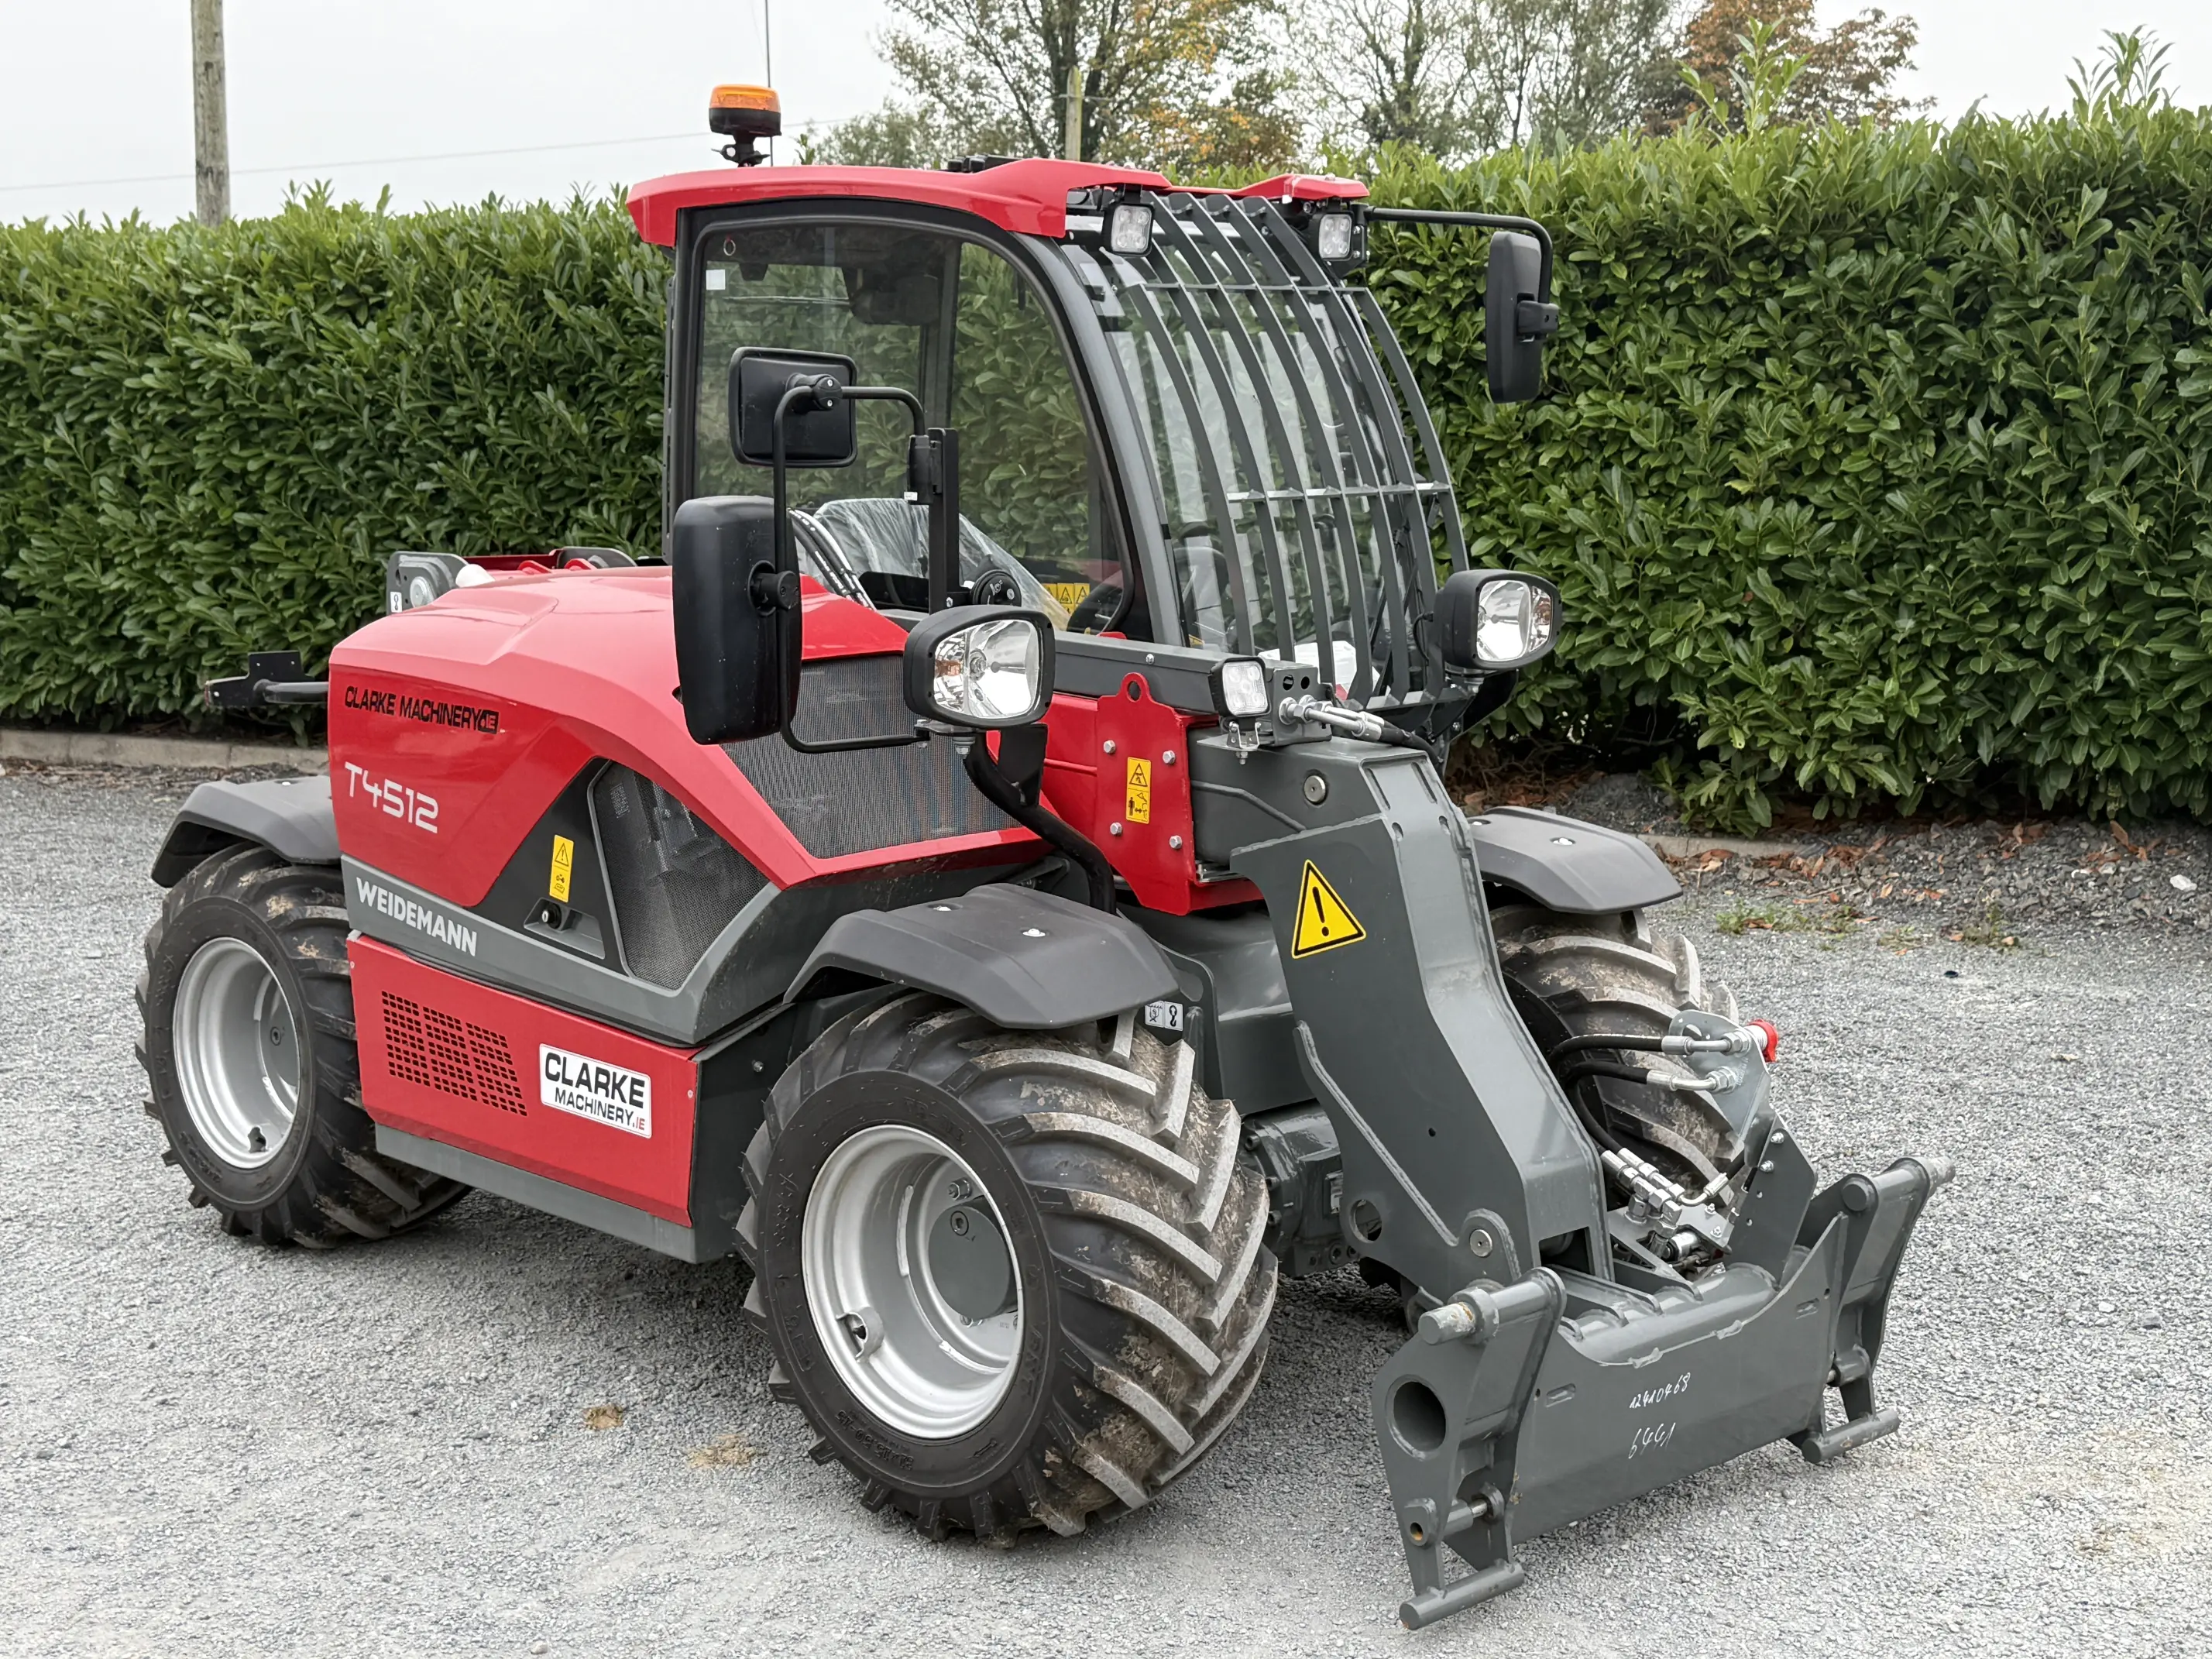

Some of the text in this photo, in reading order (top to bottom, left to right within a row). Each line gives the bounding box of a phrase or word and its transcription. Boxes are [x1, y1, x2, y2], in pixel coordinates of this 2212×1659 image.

[345, 685, 396, 716] CLARKE
[345, 761, 439, 834] T4512
[356, 877, 477, 957] WEIDEMANN
[545, 1052, 645, 1109] CLARKE
